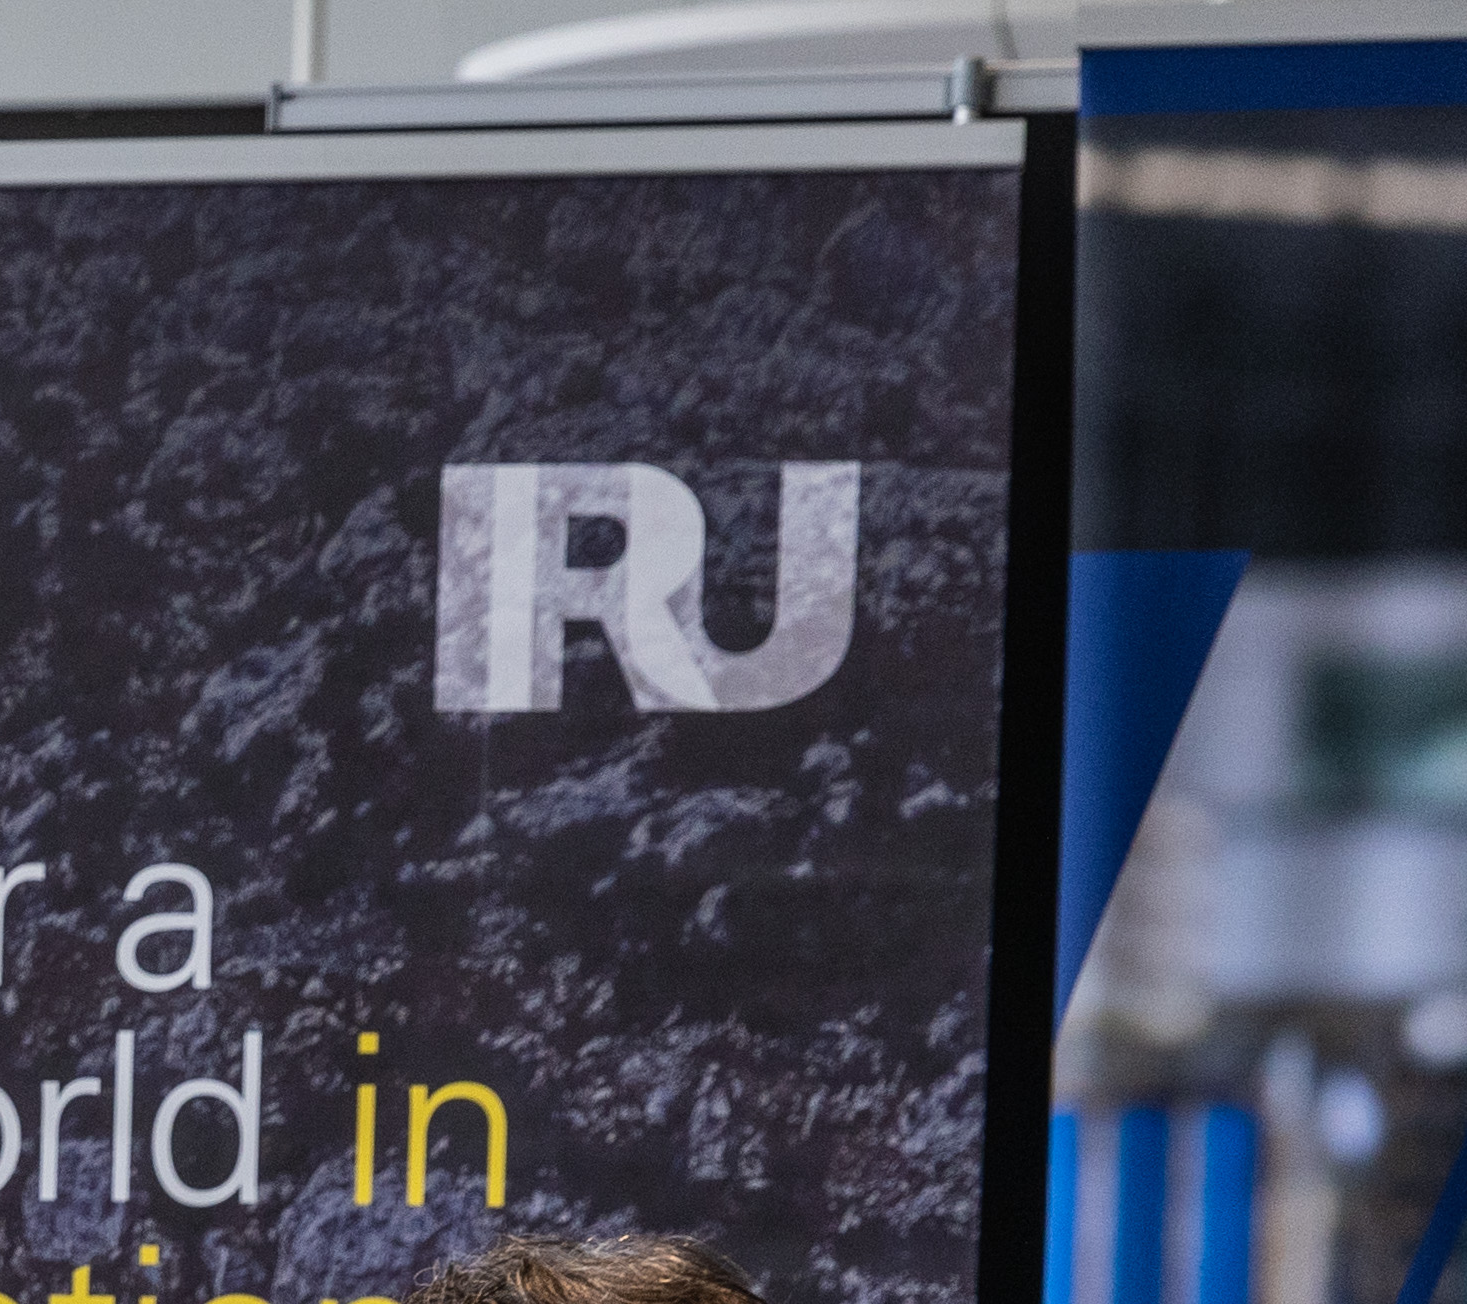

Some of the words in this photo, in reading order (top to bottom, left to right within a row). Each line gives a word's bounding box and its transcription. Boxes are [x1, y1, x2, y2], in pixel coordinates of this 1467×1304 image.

[433, 460, 861, 712] IRU
[115, 861, 214, 991] a
[353, 1031, 509, 1208] in
